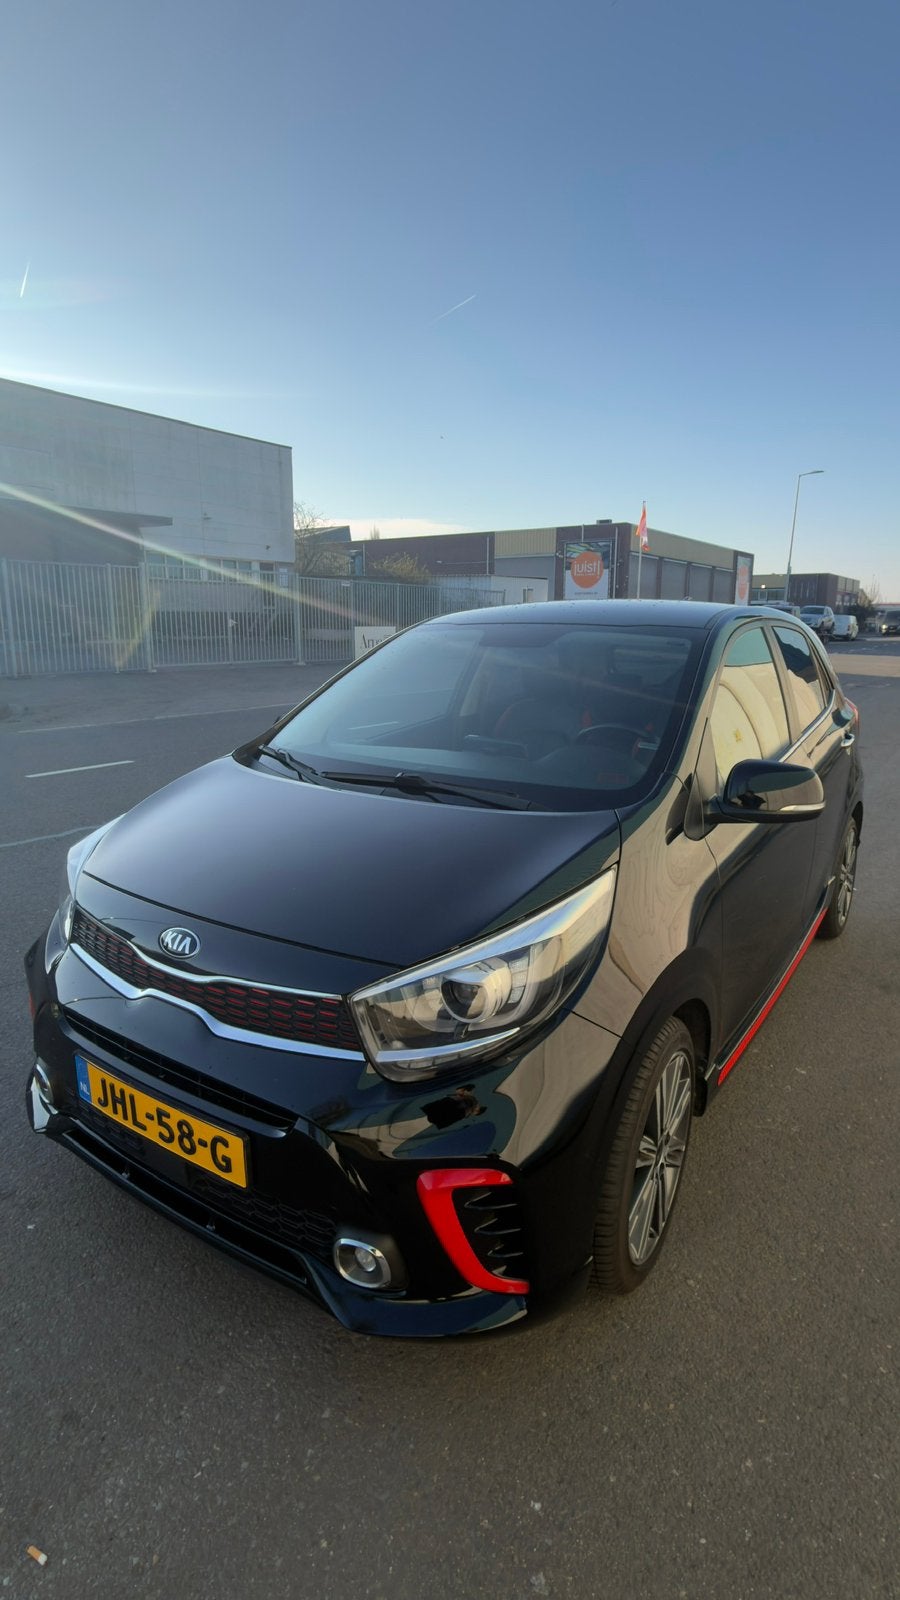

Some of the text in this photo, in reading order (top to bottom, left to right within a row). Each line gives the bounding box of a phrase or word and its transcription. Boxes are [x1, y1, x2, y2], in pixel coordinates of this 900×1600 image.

[163, 930, 191, 954] KIA
[79, 1081, 90, 1095] NL
[97, 1077, 232, 1173] JHL-58-G
